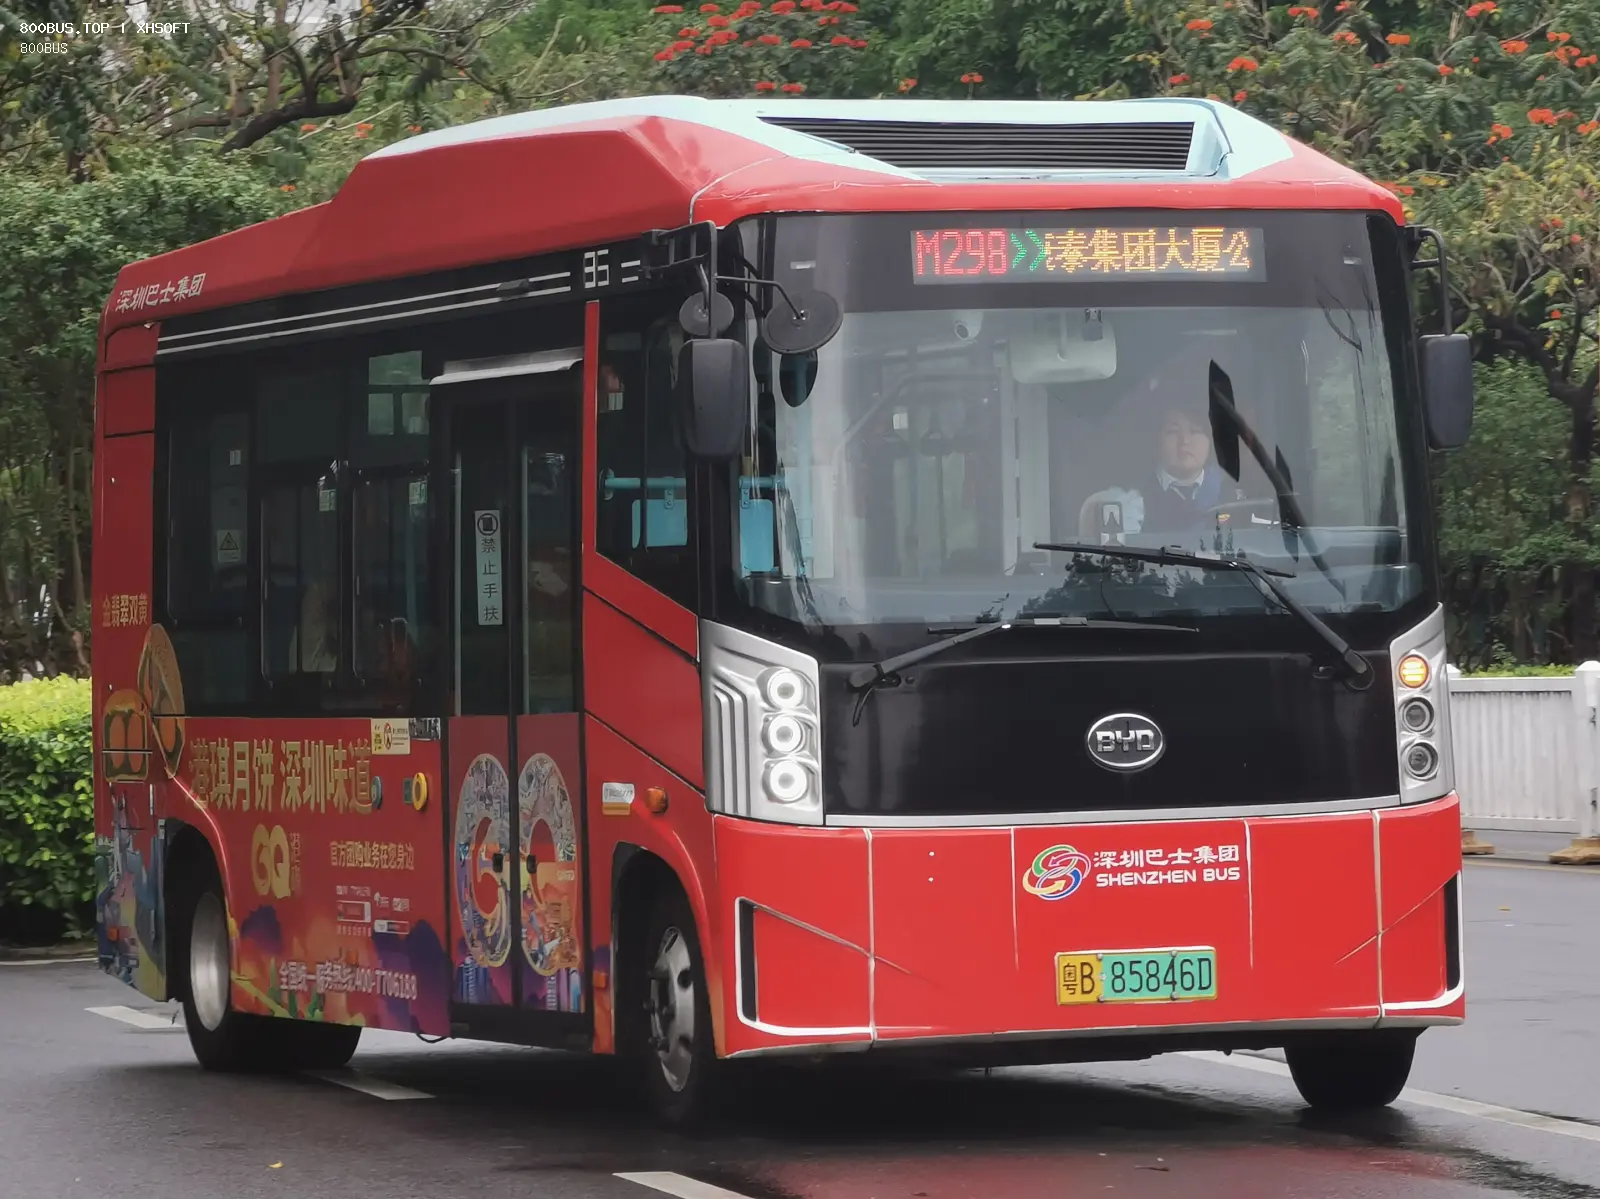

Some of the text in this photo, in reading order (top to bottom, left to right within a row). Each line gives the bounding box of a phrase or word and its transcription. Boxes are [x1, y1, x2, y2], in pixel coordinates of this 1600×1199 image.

[915, 229, 1007, 276] M298
[115, 273, 206, 313] 深圳巴士集团
[480, 537, 500, 622] 禁止手扶
[1095, 729, 1155, 752] BYD
[280, 738, 373, 815] 深圳味道
[329, 840, 415, 871] 官方团购业务在您身边
[1093, 844, 1240, 869] 深圳巴士集团
[1096, 866, 1241, 888] SHENZHEN BUS
[1062, 957, 1213, 996] 粤B 85846D
